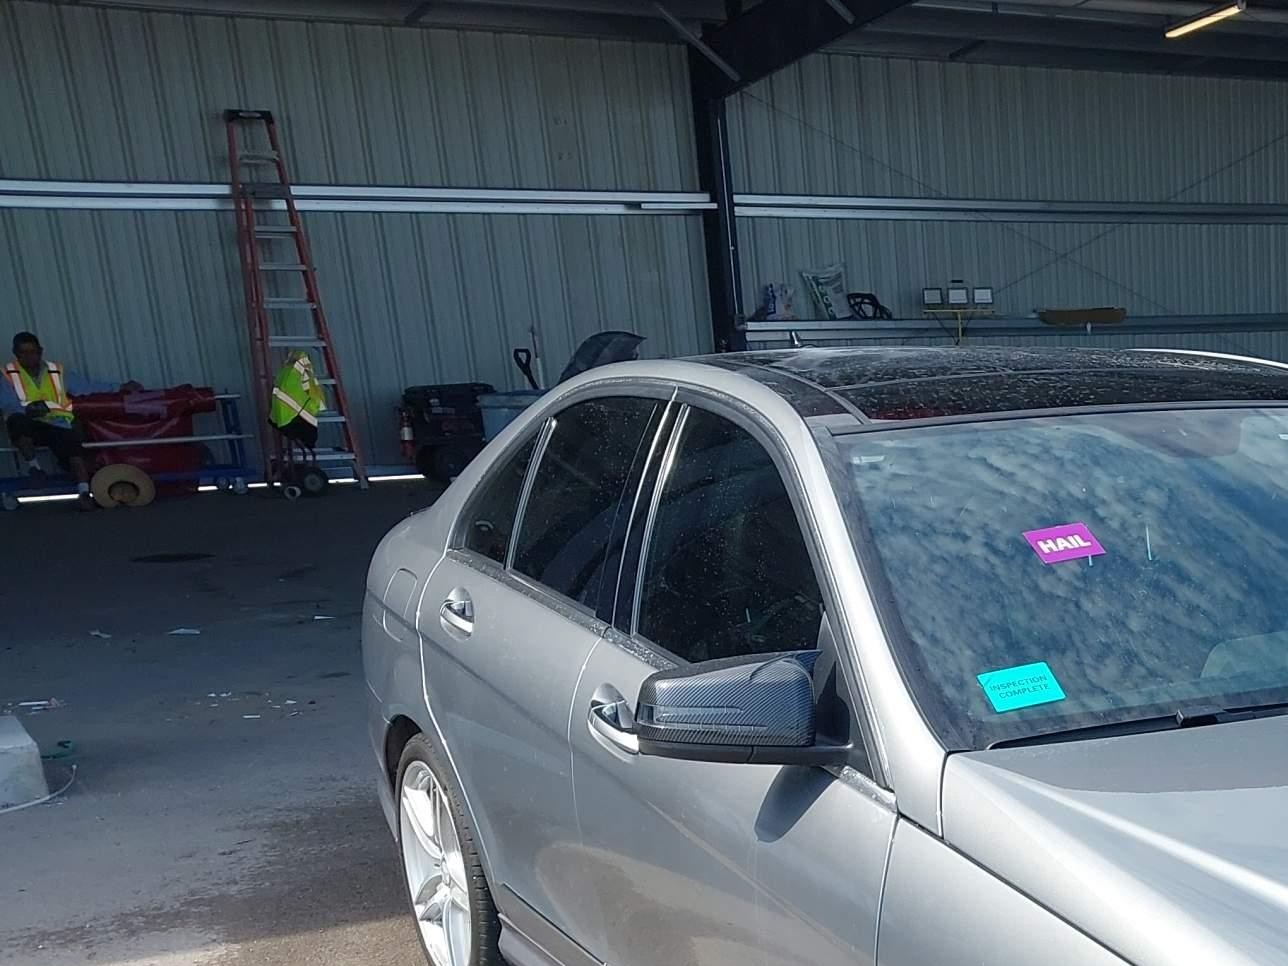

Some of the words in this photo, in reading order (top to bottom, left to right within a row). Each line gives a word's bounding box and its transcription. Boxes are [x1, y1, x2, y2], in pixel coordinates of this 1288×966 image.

[1036, 534, 1092, 554] HAIL
[989, 674, 1048, 691] INSPECTION
[999, 683, 1050, 698] COMPLETE
